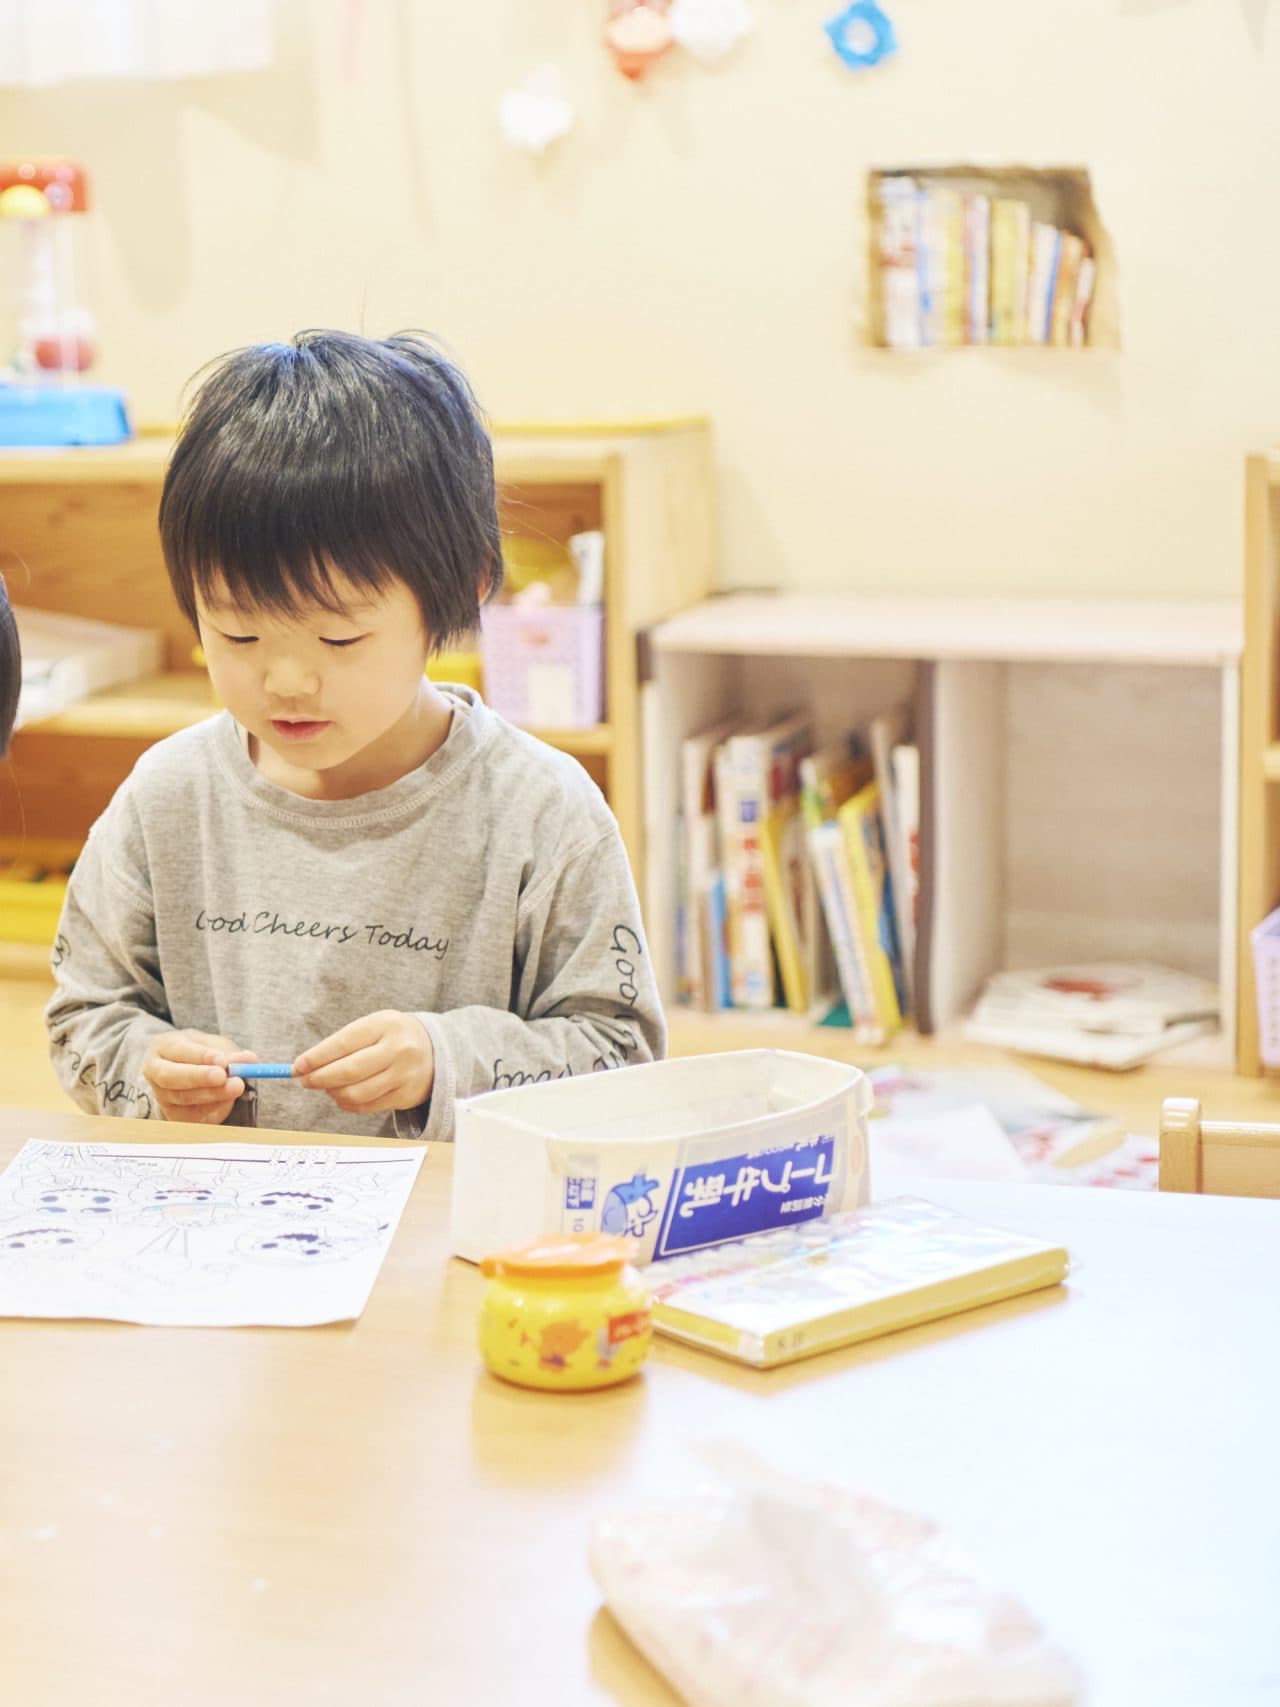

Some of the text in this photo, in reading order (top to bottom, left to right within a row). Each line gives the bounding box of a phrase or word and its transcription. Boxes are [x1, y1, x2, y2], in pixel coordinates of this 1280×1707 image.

[253, 911, 357, 944] Cheers
[365, 924, 450, 961] Today
[679, 1152, 834, 1218] コープ牛乳
